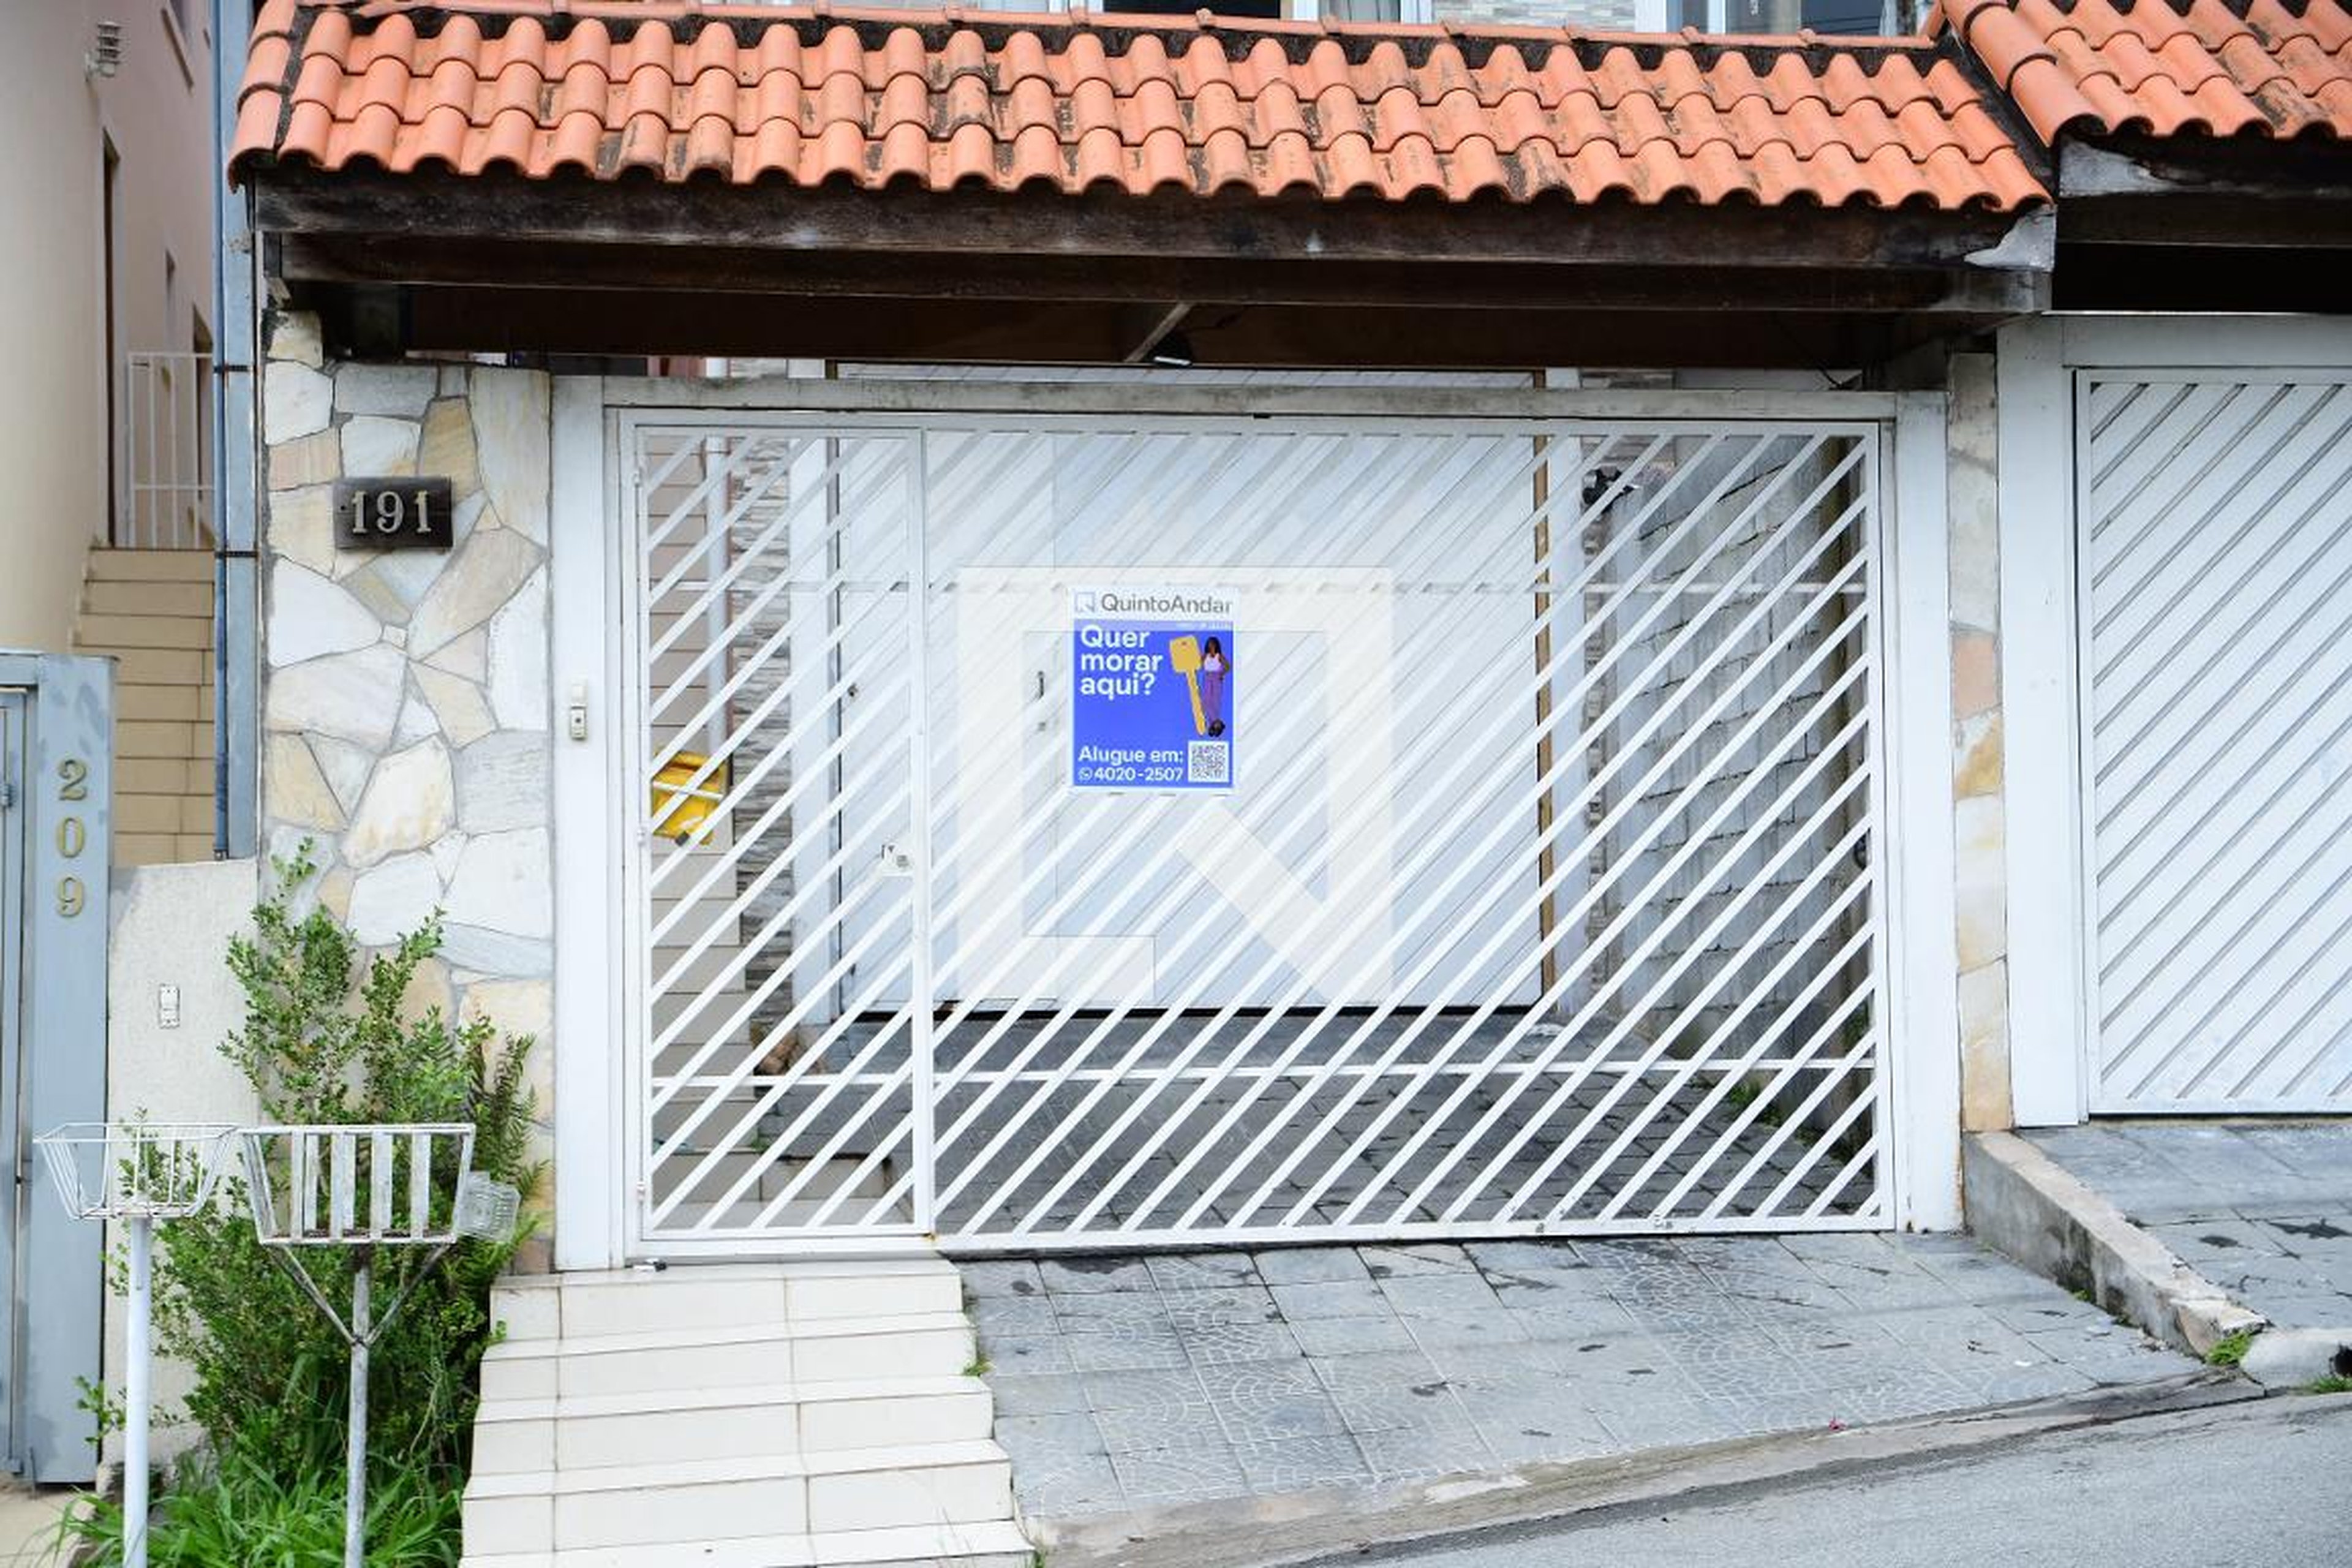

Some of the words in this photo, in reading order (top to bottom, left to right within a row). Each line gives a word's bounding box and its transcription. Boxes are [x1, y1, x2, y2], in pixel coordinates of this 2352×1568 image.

[352, 491, 431, 533] 191
[1101, 594, 1233, 613] QuintoAndar
[1081, 625, 1150, 647] Quer
[1081, 653, 1163, 671] morar
[1080, 673, 1155, 700] aqui?
[1079, 746, 1145, 766] Alugue
[1151, 749, 1183, 763] em:
[57, 759, 88, 918] 209
